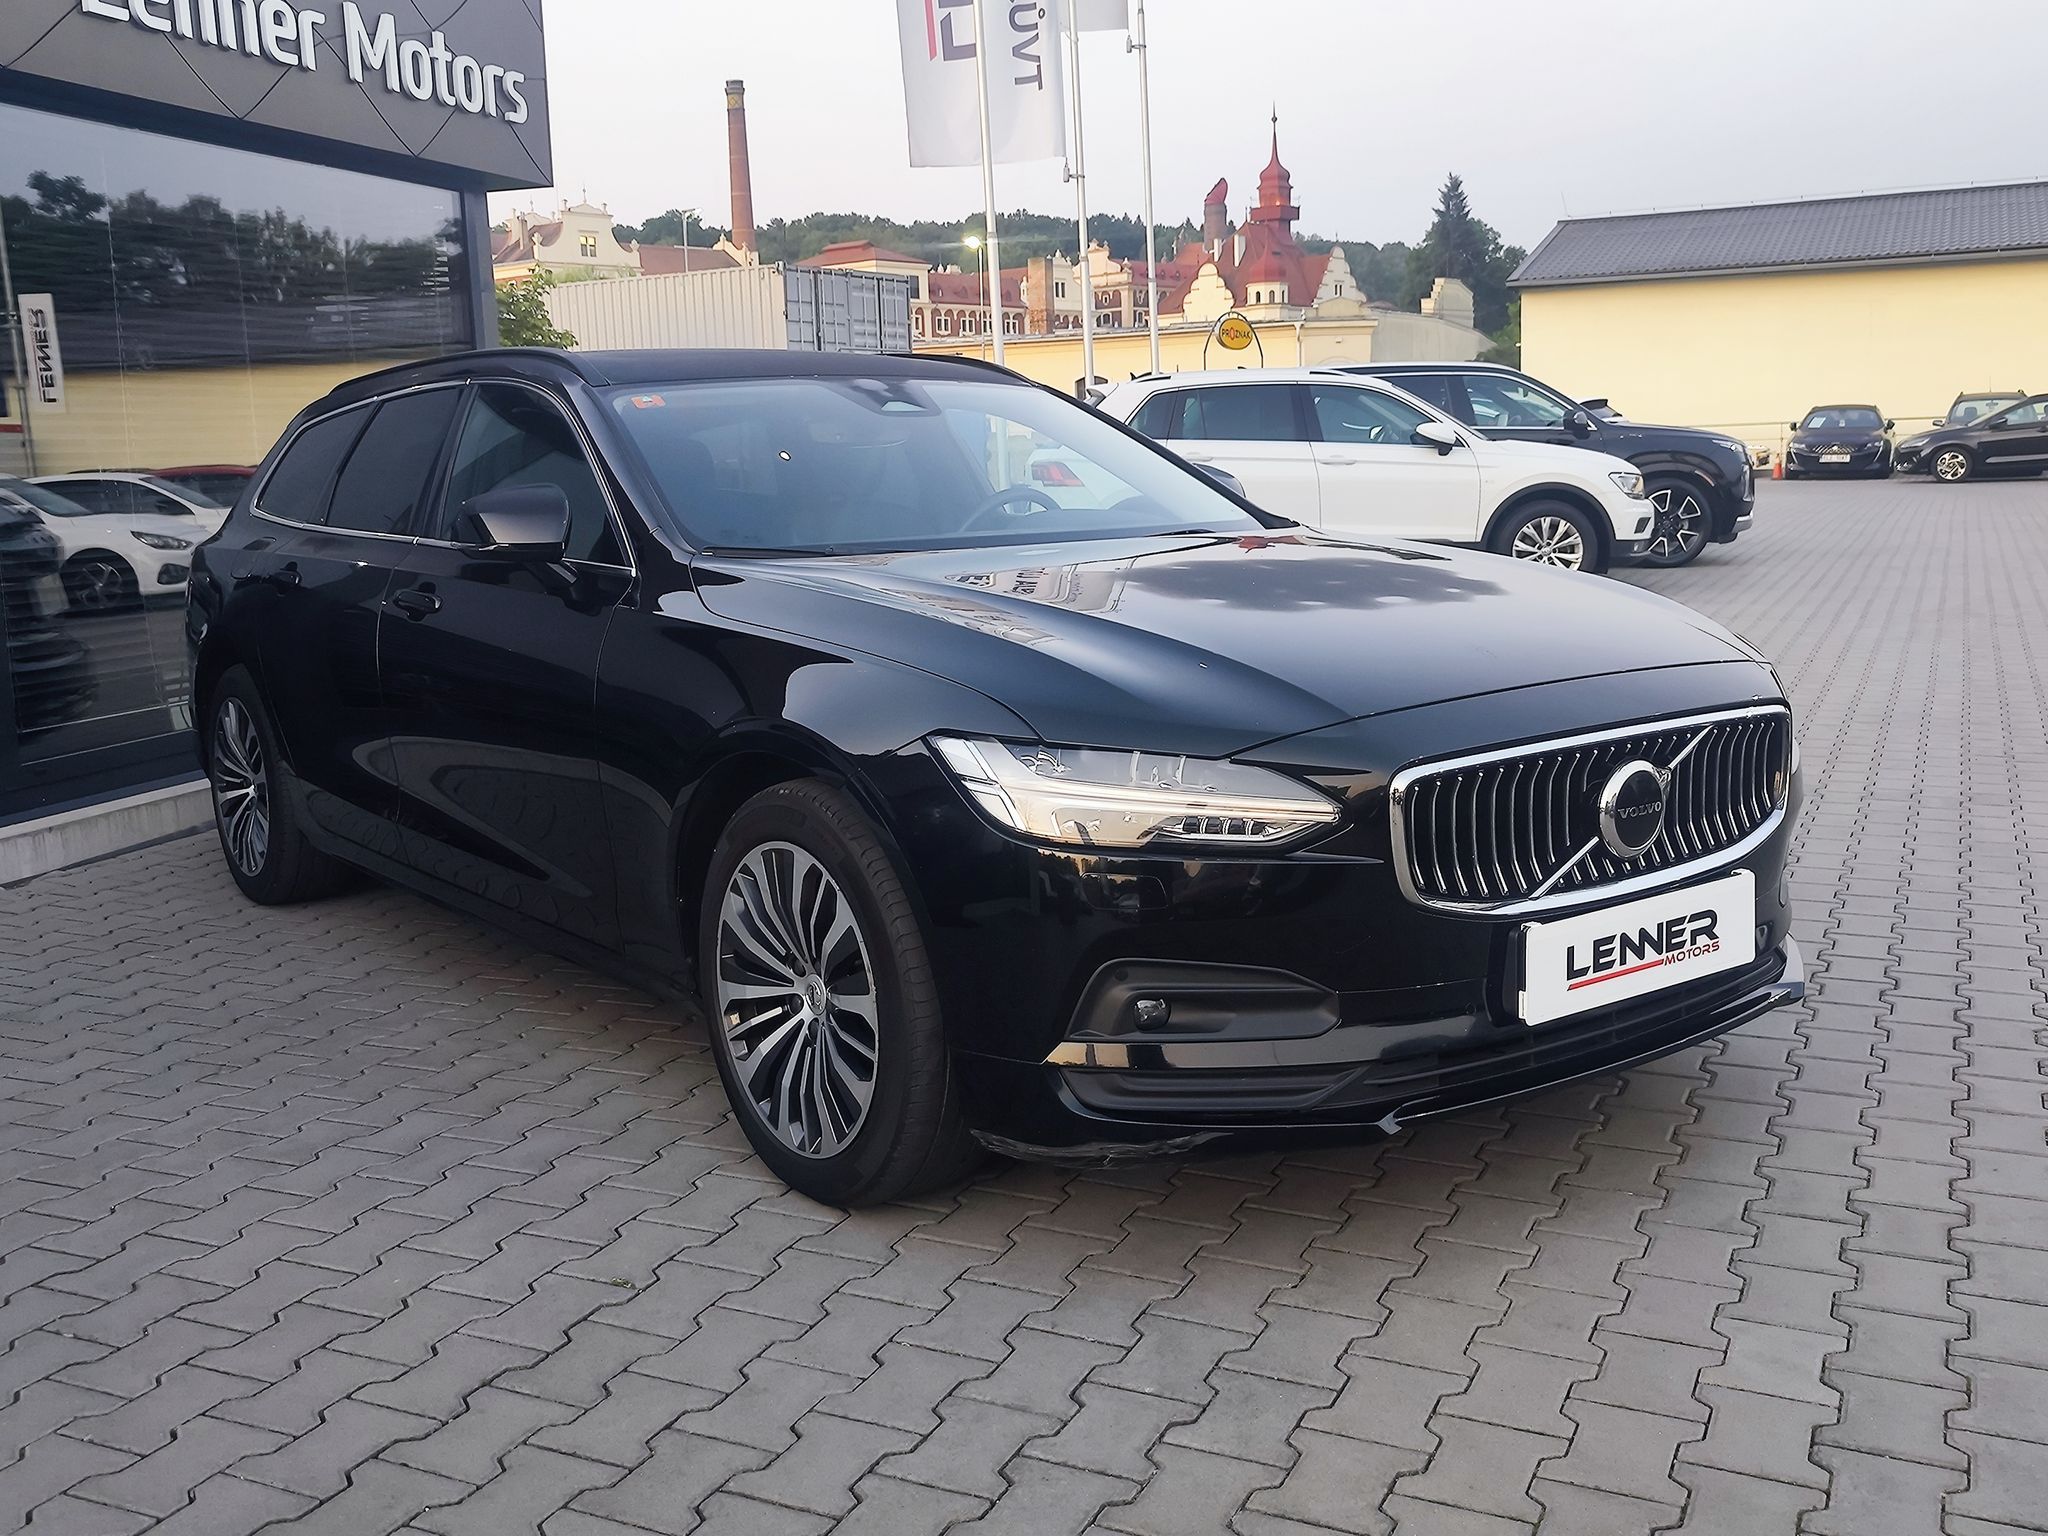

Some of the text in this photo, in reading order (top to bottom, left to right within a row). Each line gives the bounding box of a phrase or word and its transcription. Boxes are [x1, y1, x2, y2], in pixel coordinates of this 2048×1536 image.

[81, 0, 529, 124] enner Motors
[1617, 801, 1662, 819] VOLVO
[1566, 909, 1720, 981] LENNER
[1664, 940, 1720, 966] MOTORS
